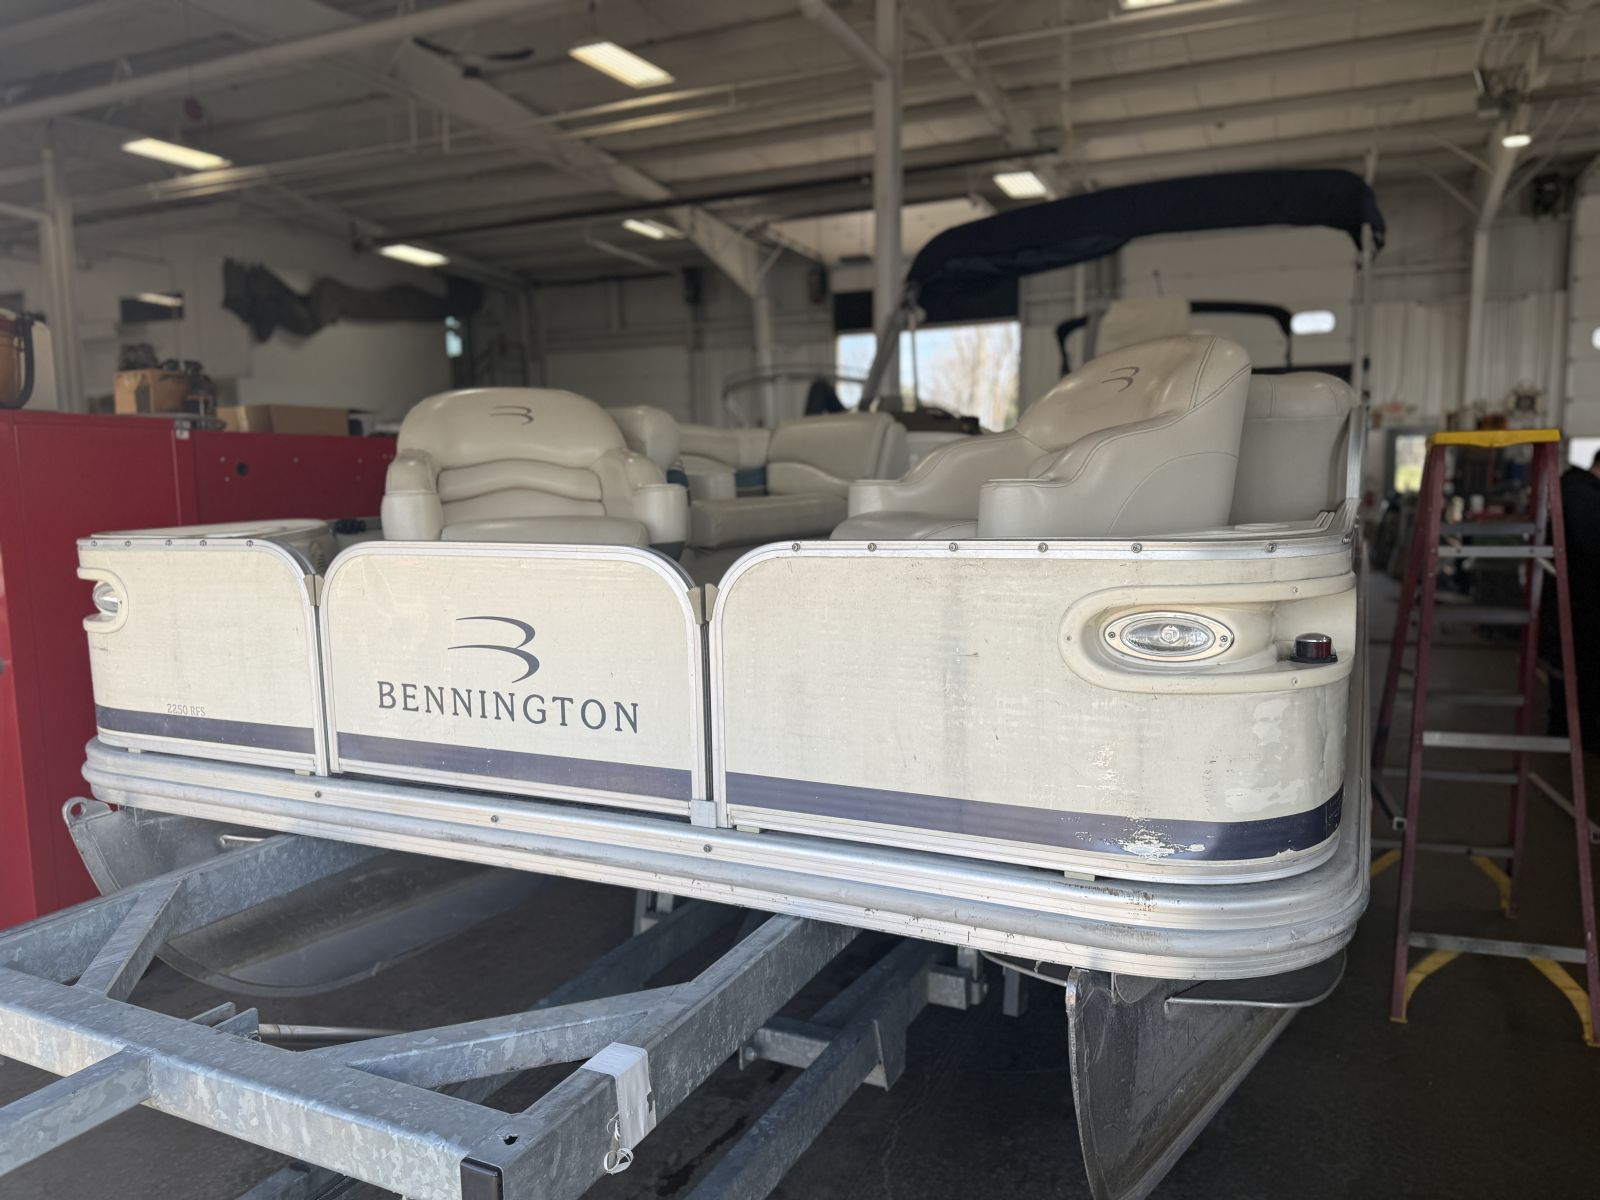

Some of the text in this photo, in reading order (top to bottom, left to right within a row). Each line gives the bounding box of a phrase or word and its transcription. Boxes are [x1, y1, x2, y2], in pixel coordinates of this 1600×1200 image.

[166, 703, 206, 717] 2250 RFS
[377, 680, 639, 734] BENNINGTON
